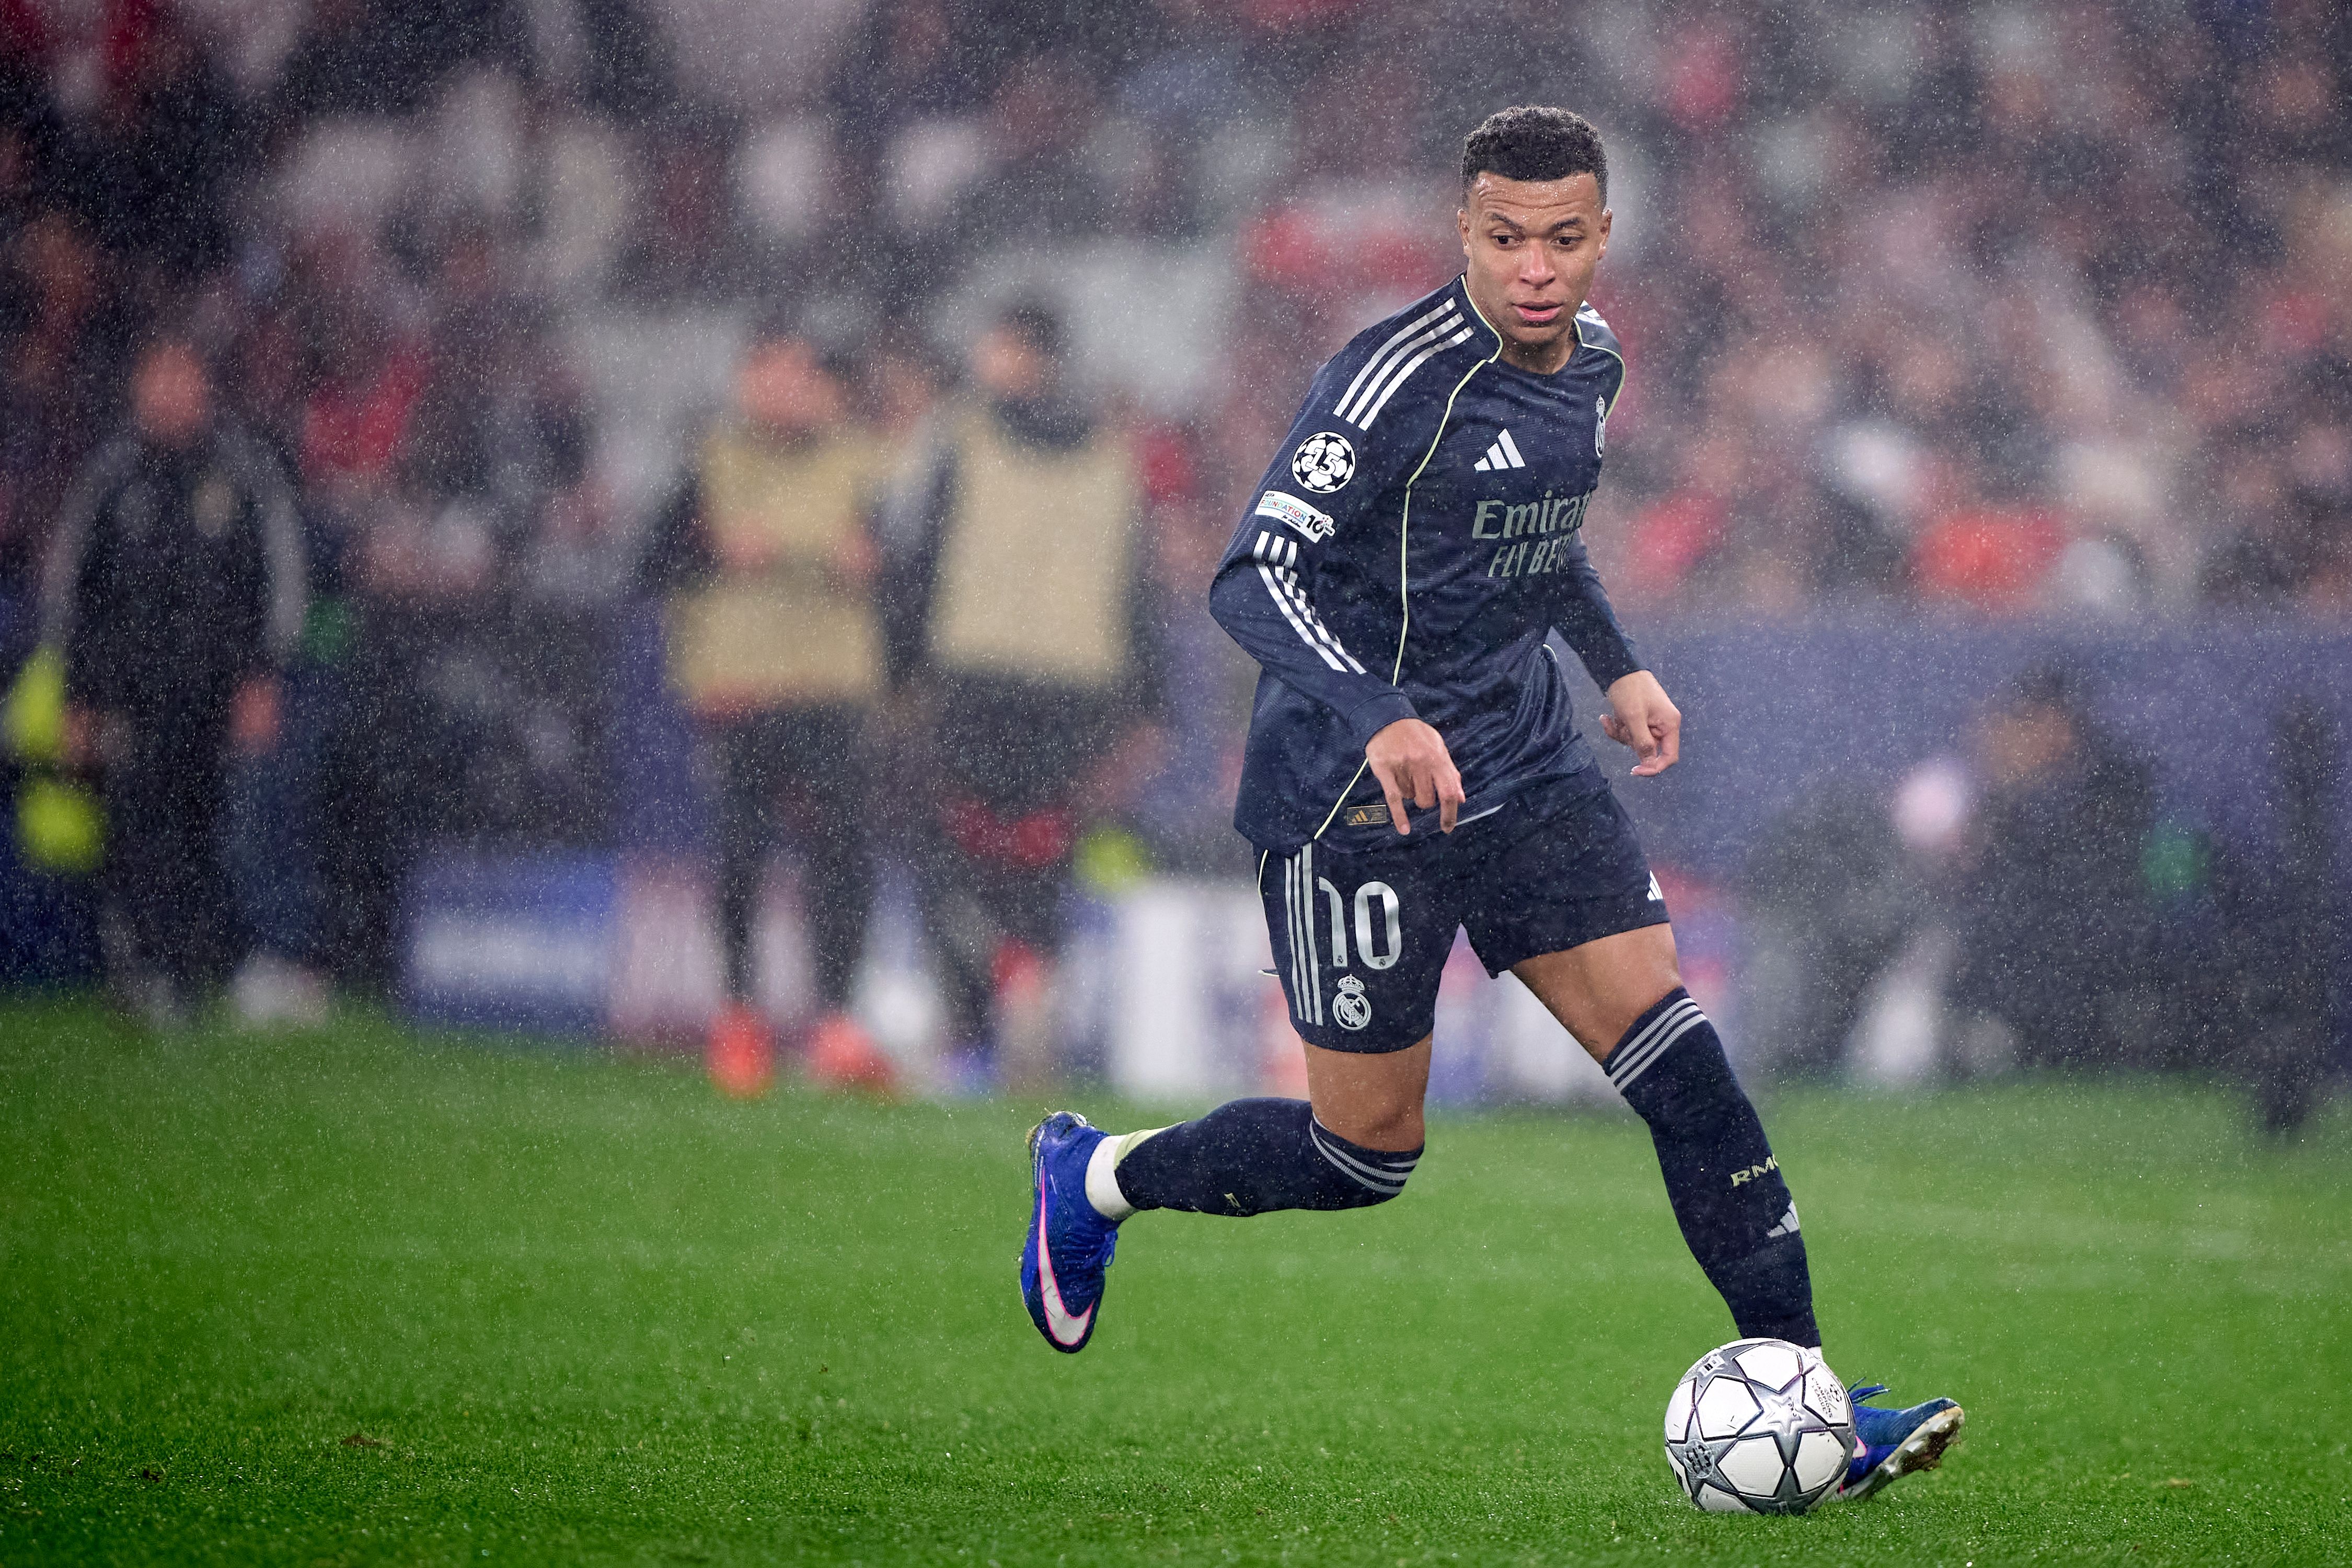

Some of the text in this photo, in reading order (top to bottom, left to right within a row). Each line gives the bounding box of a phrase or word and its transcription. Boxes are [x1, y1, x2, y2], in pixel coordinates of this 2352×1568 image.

[1305, 447, 1341, 476] 15
[1260, 500, 1307, 521] FOUNDATION
[1488, 541, 1529, 577] FLY
[1318, 876, 1402, 970] 10
[1812, 1377, 1833, 1417] CHAMPIONS
